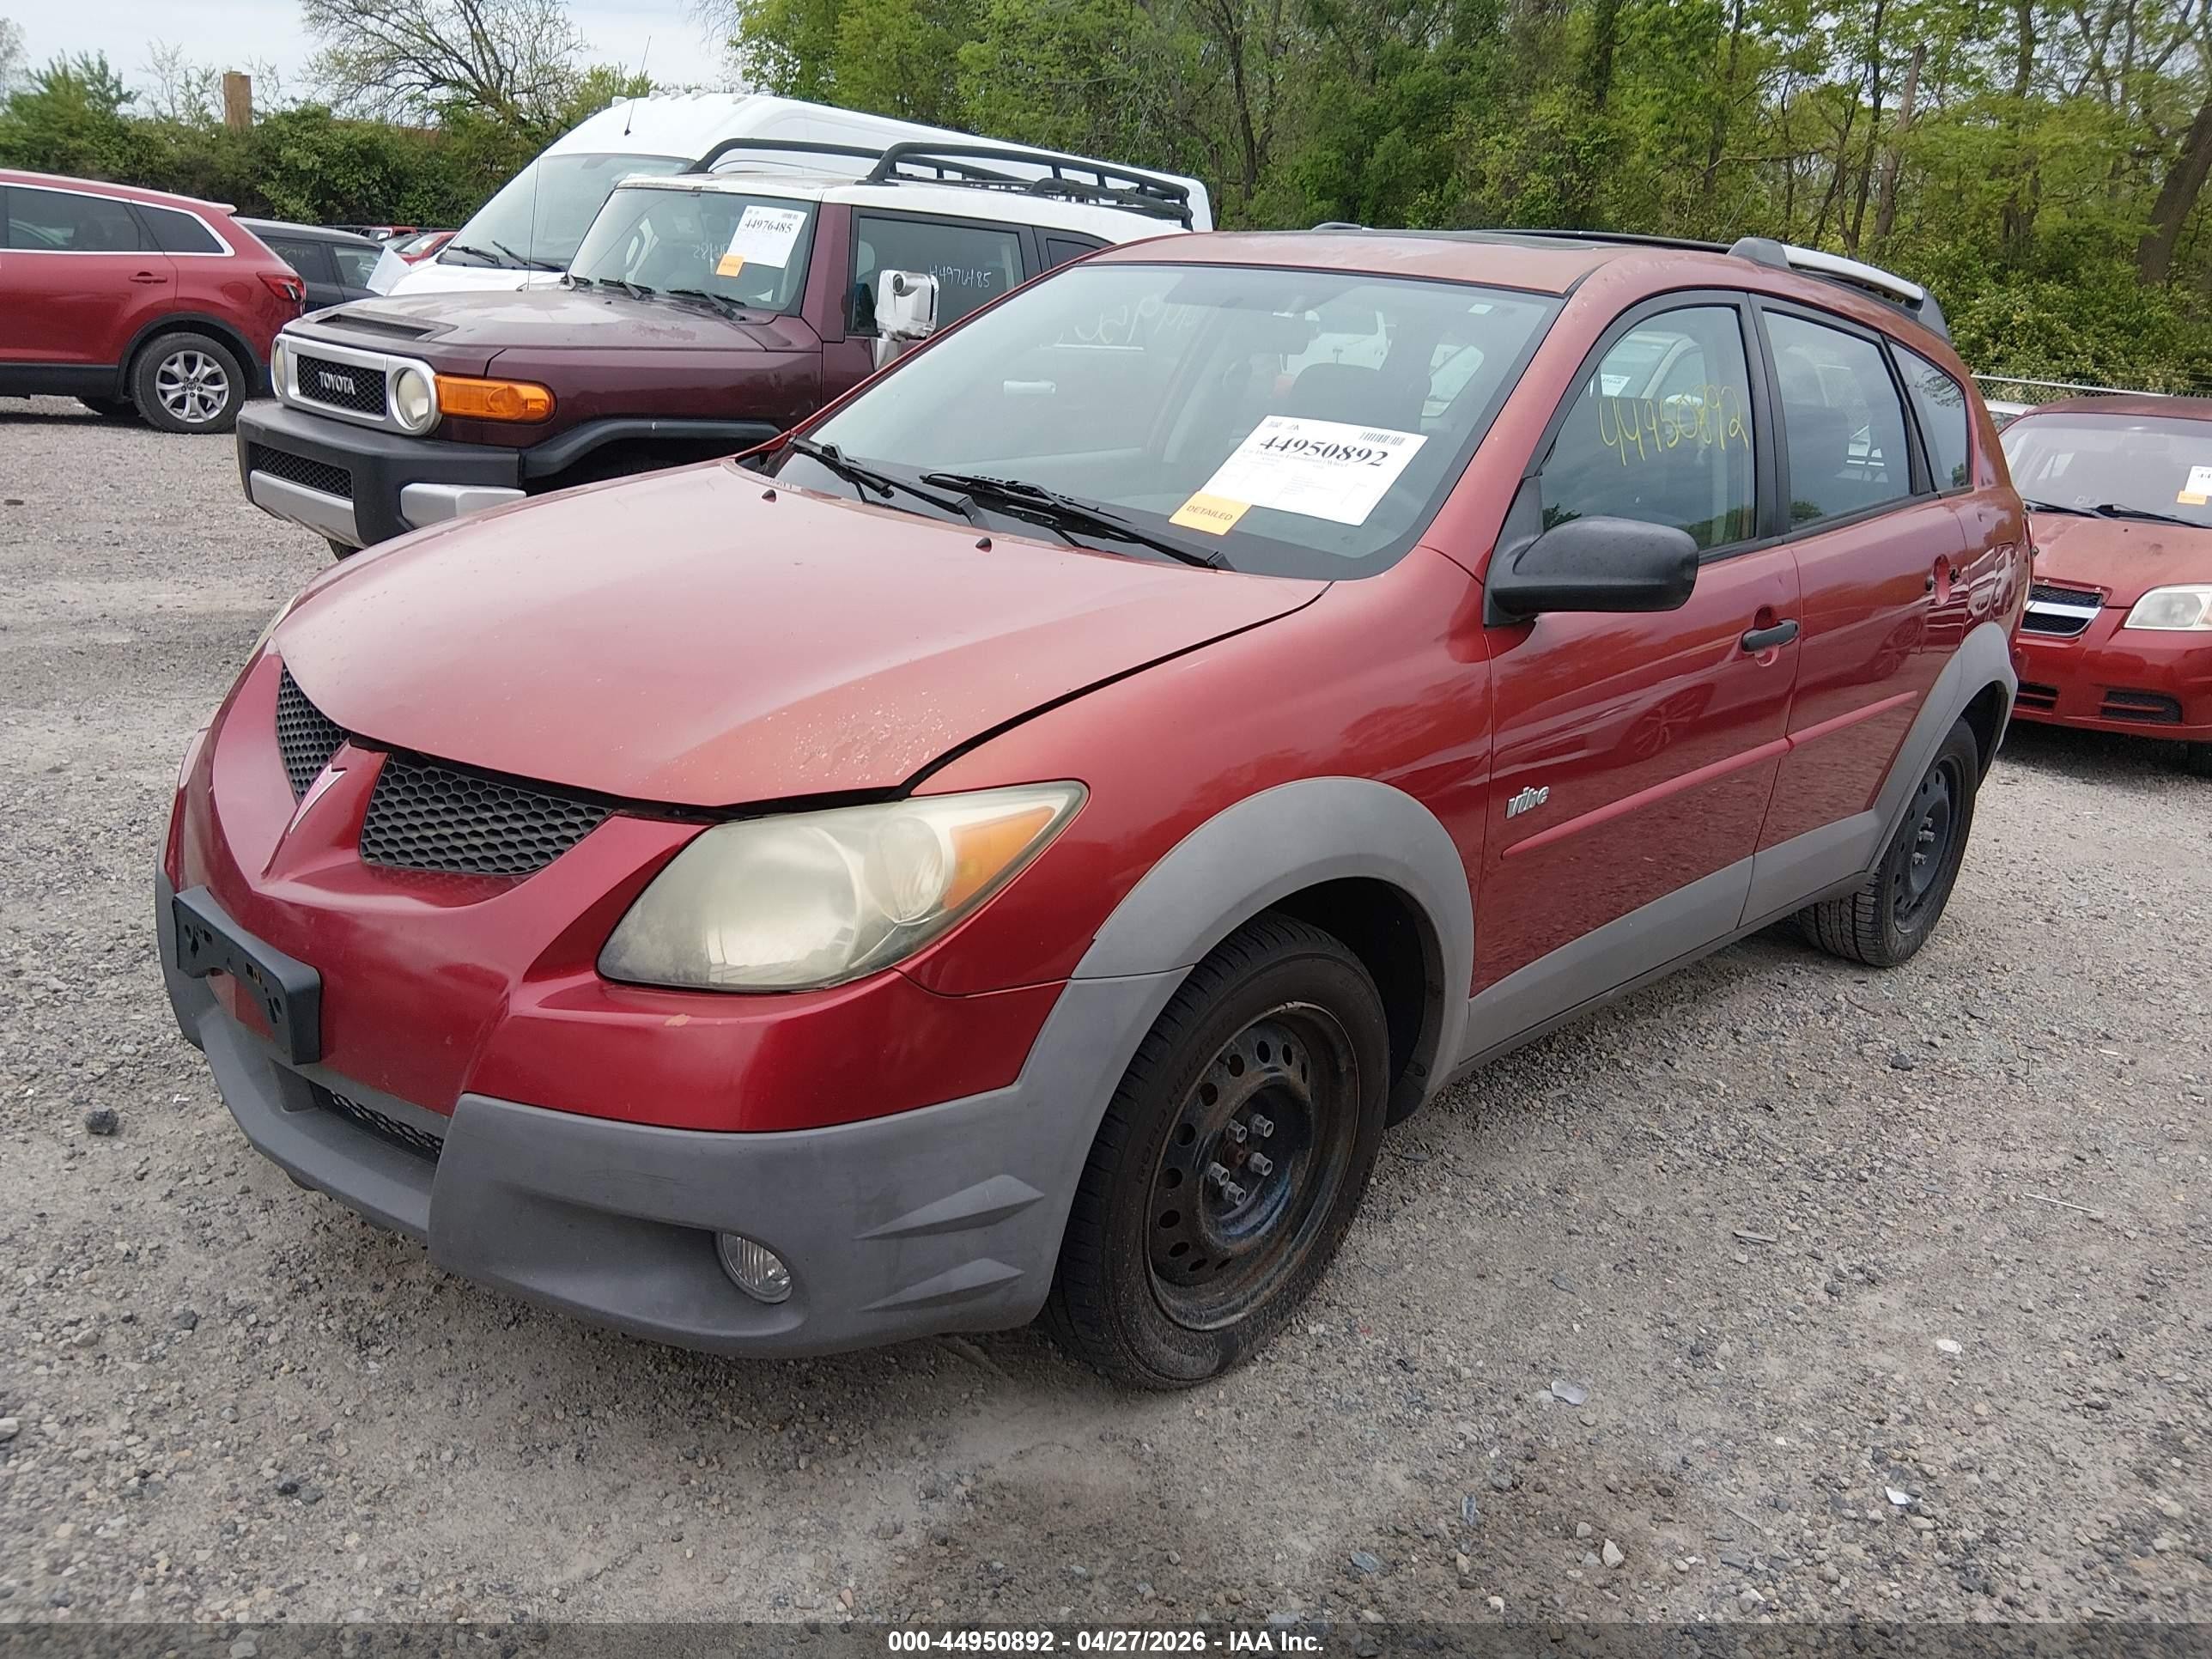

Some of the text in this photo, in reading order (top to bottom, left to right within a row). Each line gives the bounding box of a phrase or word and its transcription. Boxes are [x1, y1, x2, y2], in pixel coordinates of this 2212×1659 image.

[744, 218, 793, 234] 44976485
[319, 371, 356, 395] TOYOTA
[1598, 385, 1748, 466] 44950892
[1260, 435, 1389, 467] 44950892
[1186, 505, 1233, 521] DETAILED
